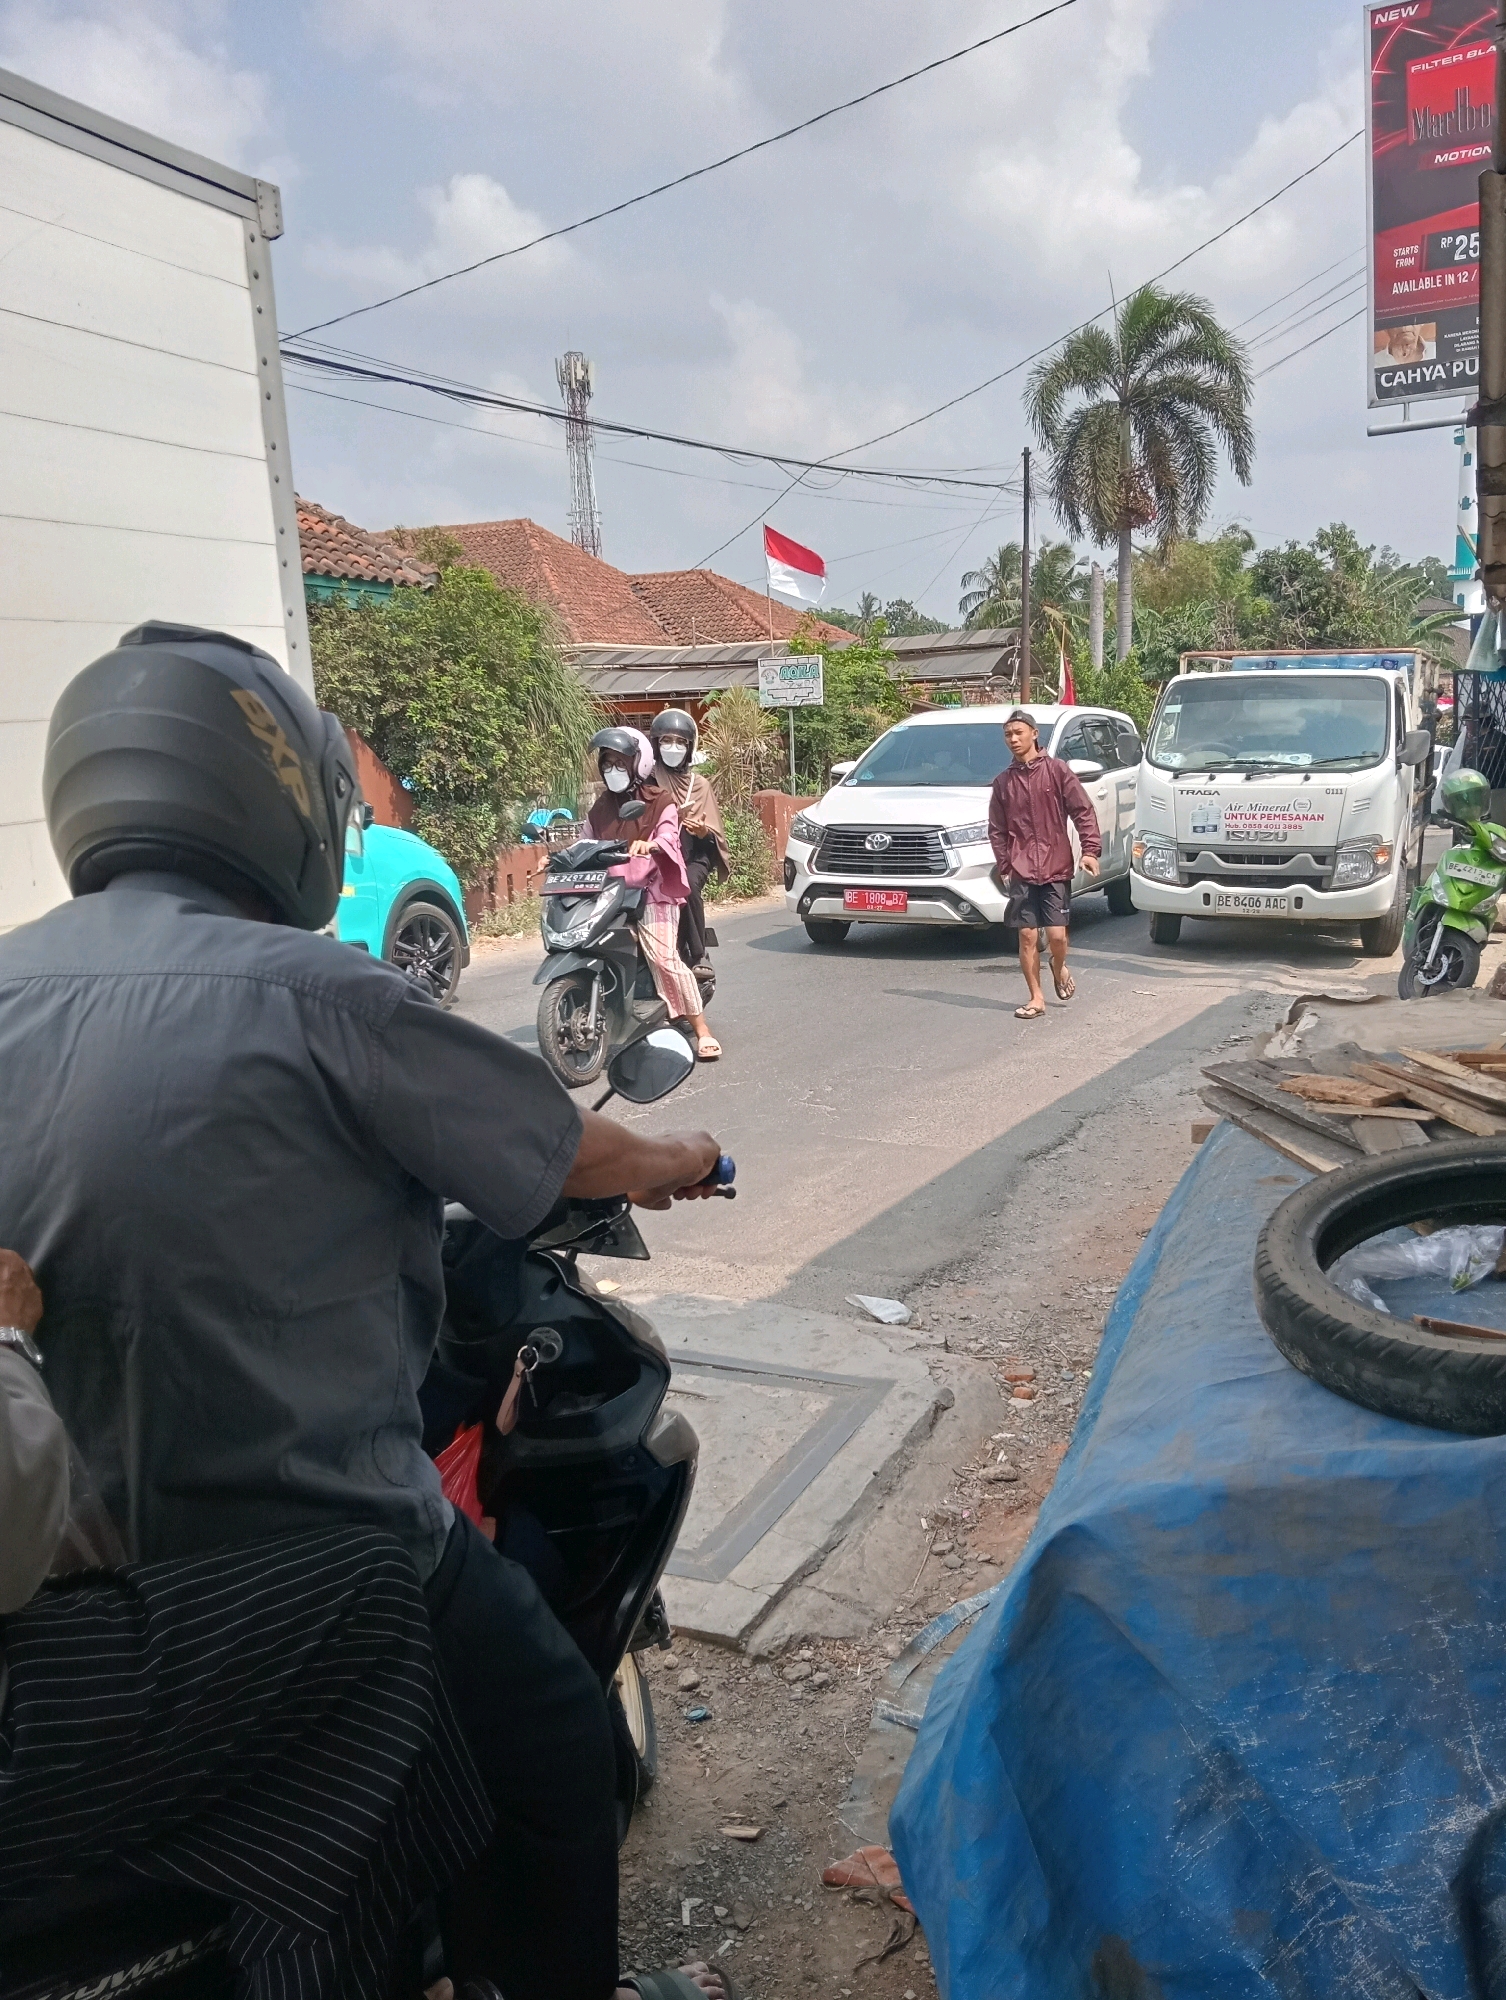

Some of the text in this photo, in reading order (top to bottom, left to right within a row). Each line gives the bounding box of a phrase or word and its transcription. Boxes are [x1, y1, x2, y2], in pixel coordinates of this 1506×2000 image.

[1374, 4, 1420, 25] NEW
[1411, 54, 1463, 73] FILTER
[1434, 145, 1492, 164] MOTION
[1393, 245, 1419, 258] STARTS
[1395, 256, 1415, 268] FROM
[1392, 275, 1442, 295] AVAILABLE
[1445, 273, 1455, 285] IN
[1457, 271, 1469, 284] 12
[1380, 363, 1447, 388] CAHYA
[1325, 787, 1344, 795] 0111
[1224, 802, 1244, 812] Air
[1247, 802, 1291, 812] Mineral
[1224, 812, 1325, 822] UNTUK PEMESANAN
[1225, 830, 1288, 842] ISUZU
[547, 875, 560, 883] BE
[584, 873, 603, 881] AAC
[845, 891, 905, 906] BE 1808 BZ
[1217, 895, 1287, 910] BE 8406 AAC
